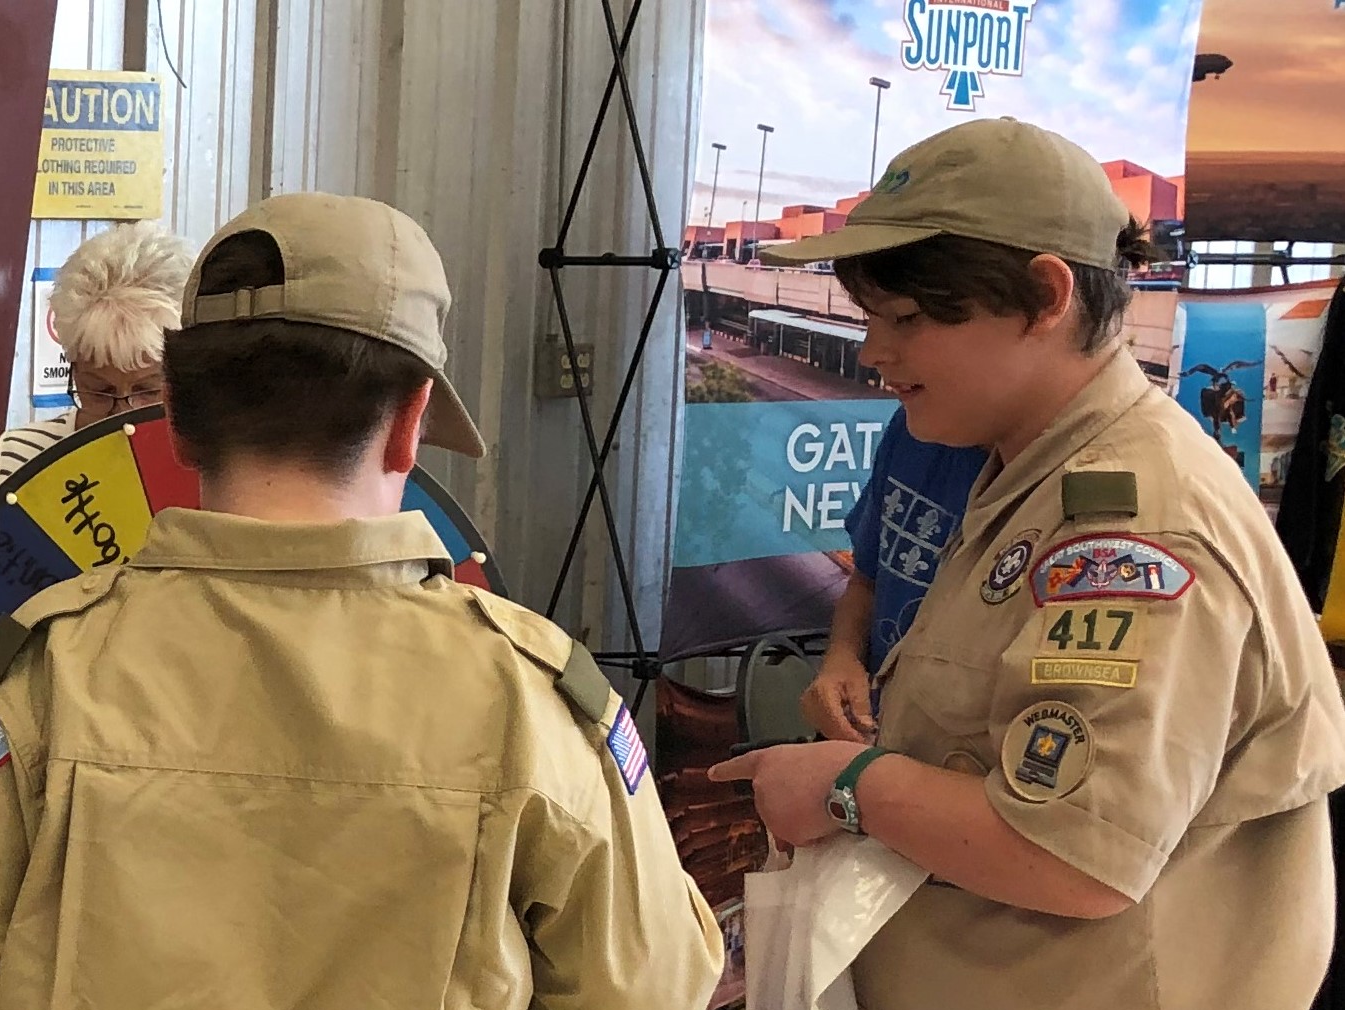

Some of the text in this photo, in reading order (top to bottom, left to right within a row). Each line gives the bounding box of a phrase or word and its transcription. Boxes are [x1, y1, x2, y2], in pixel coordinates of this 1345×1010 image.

[905, 0, 1029, 71] SUNPORT
[51, 137, 116, 153] PROTECTIVE
[38, 158, 137, 175] OTHING REQUIRED
[48, 181, 116, 196] IN THIS AREA
[786, 422, 884, 473] GAT
[782, 481, 862, 533] NE
[1092, 548, 1118, 559] BSA
[1134, 544, 1180, 573] COUNCIL
[1046, 608, 1134, 651] 417
[1043, 663, 1121, 680] BROWNSEA
[1022, 708, 1086, 745] WEBMASTER
